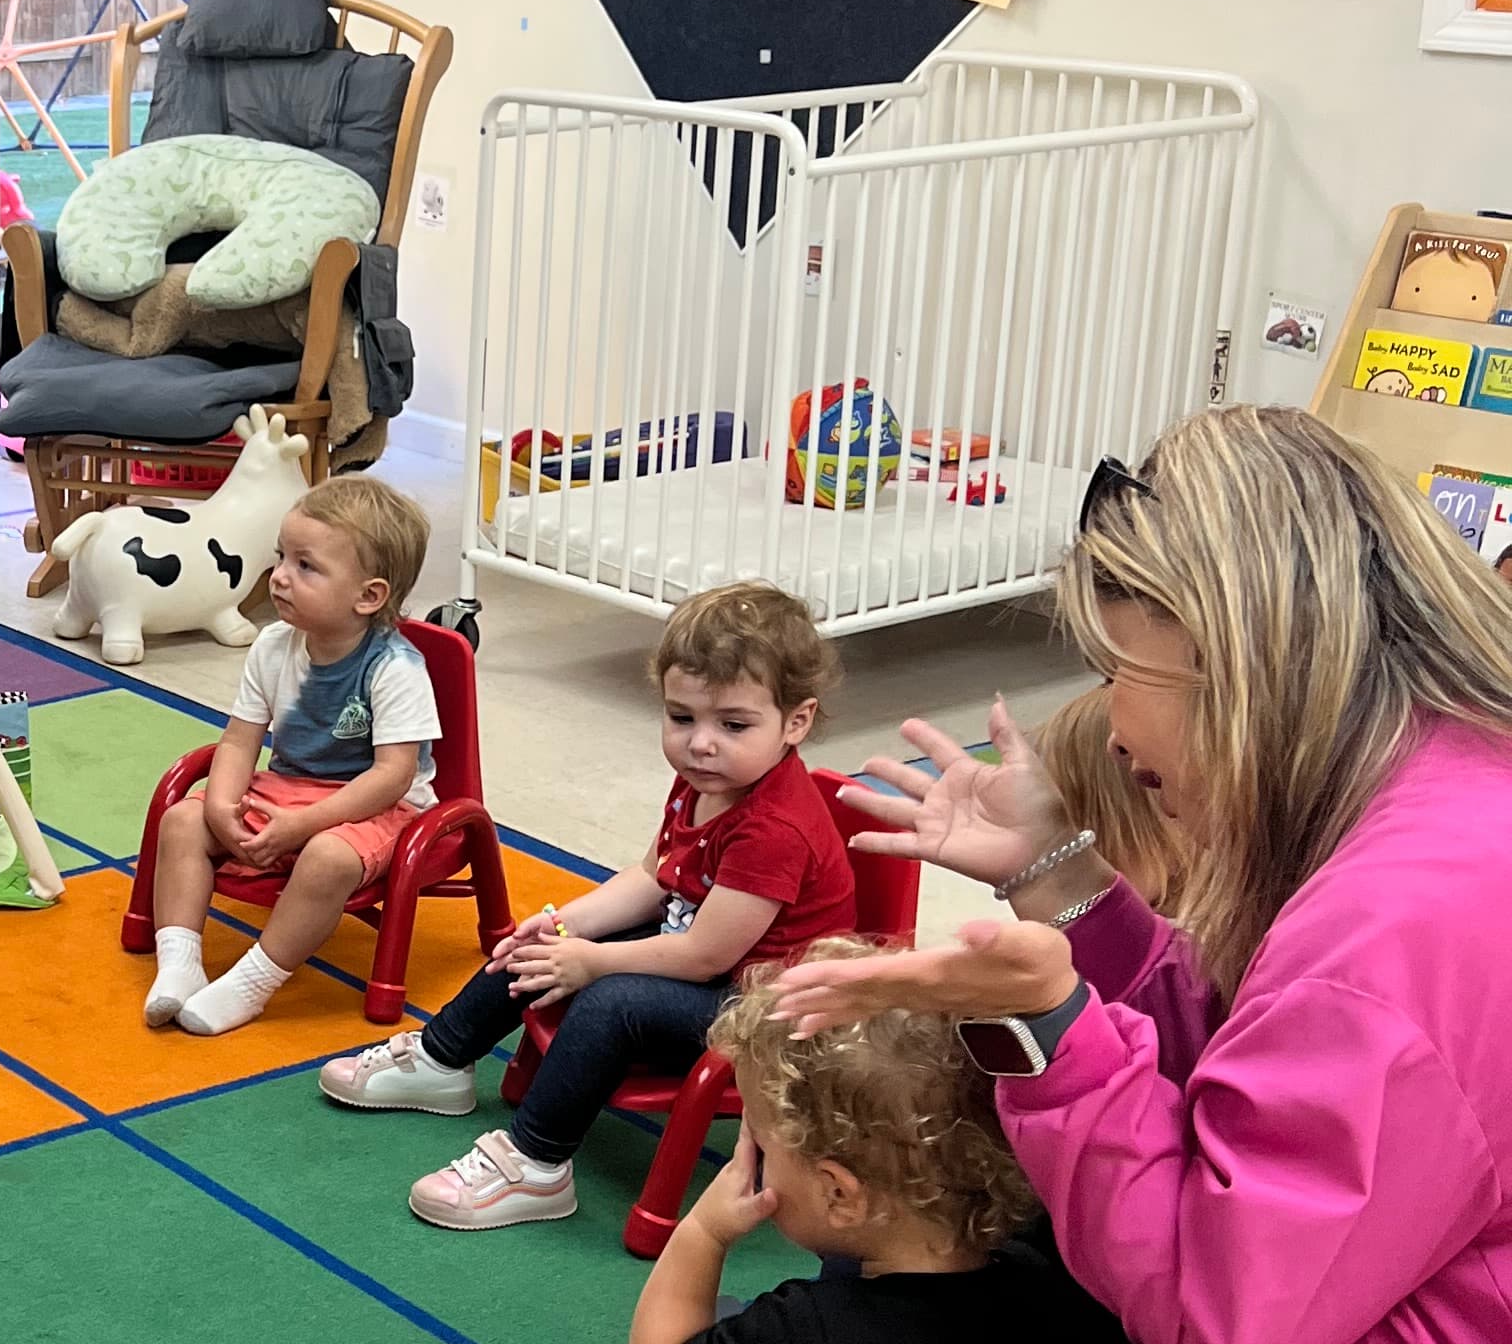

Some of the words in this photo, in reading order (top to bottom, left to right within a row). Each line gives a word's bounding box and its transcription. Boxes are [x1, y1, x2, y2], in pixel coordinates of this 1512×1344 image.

[1368, 342, 1388, 354] Baby
[1389, 342, 1437, 361] HAPPY
[1407, 361, 1428, 375] Baby
[1431, 363, 1461, 378] SAD
